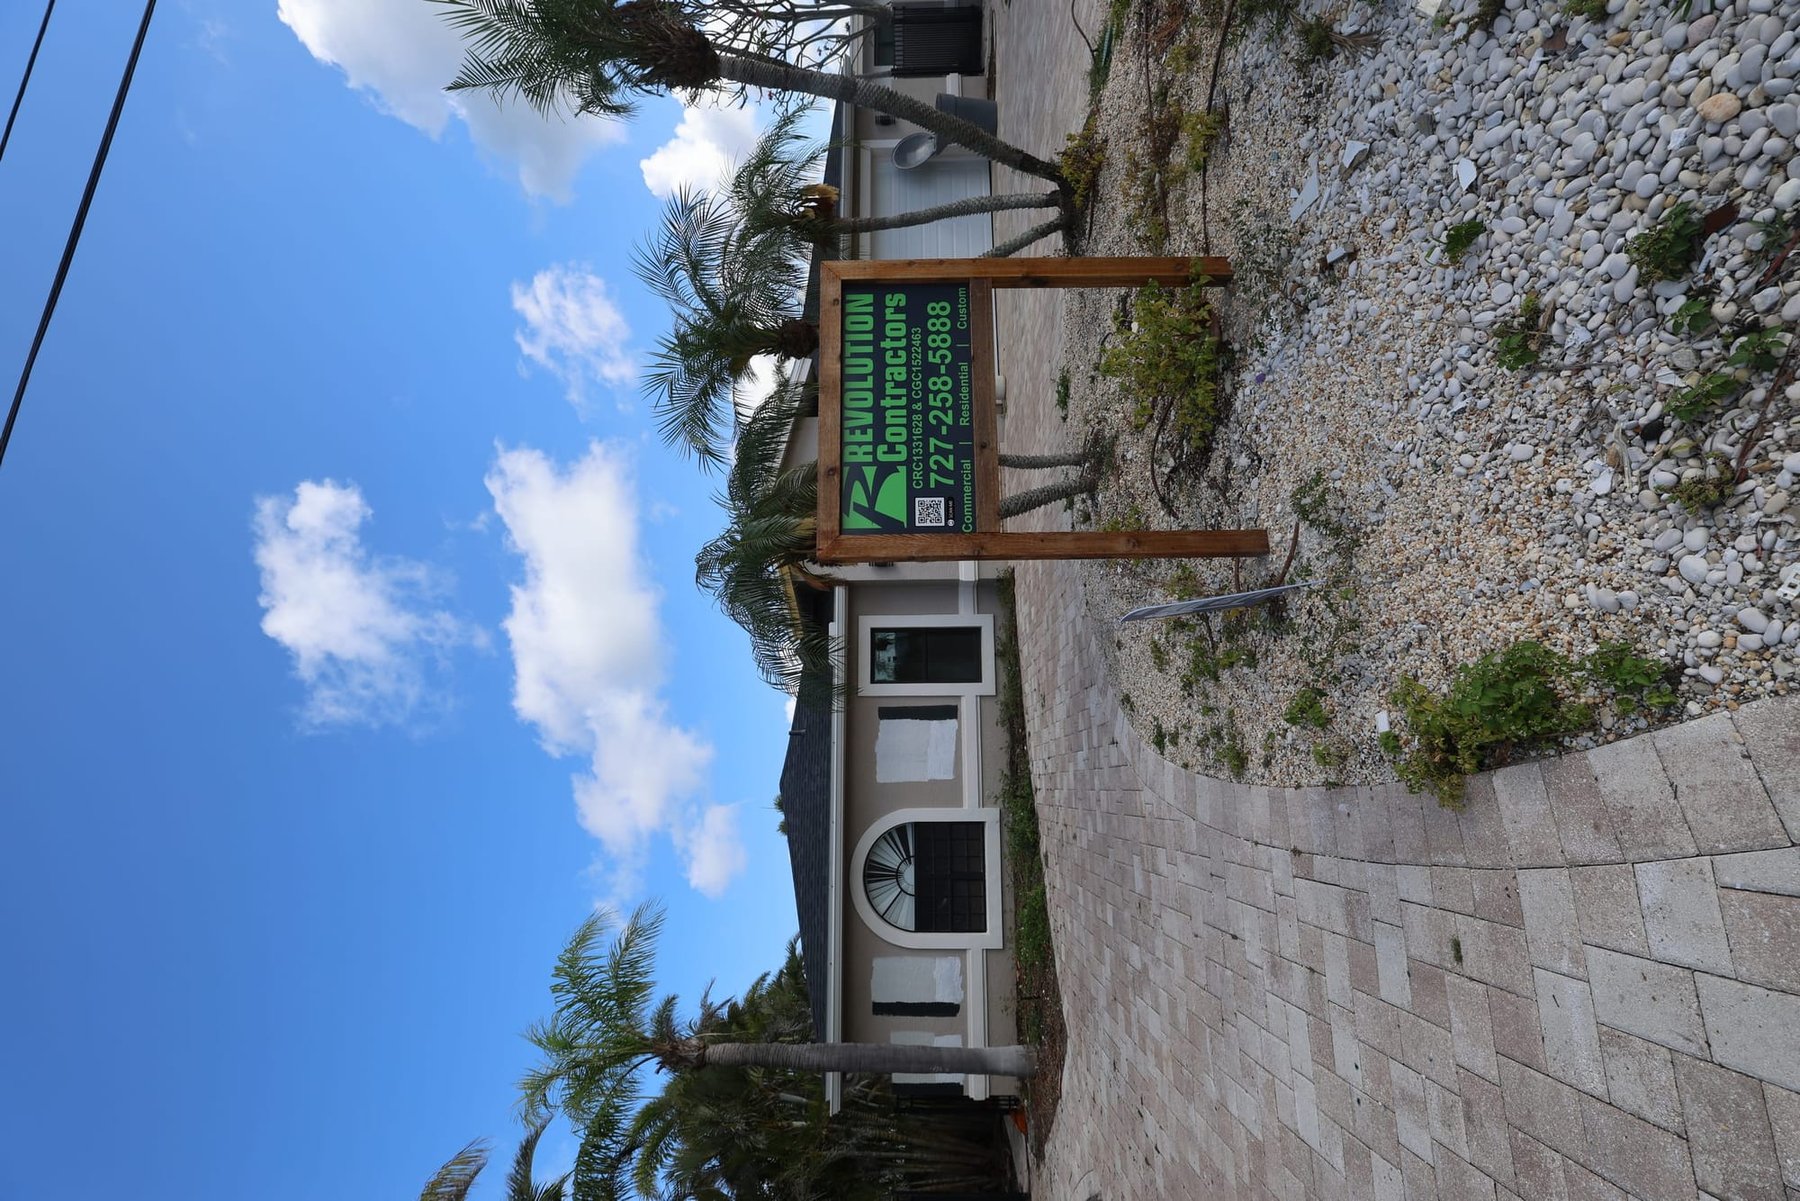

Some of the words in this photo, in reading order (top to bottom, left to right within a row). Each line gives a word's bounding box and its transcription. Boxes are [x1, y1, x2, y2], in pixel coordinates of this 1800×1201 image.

[957, 287, 967, 329] Custom
[843, 293, 874, 463] REVOLUTION
[876, 293, 907, 462] Contractors
[911, 327, 922, 399] CGC1522463
[927, 301, 954, 489] 727-258-5888
[958, 362, 970, 426] Residential
[912, 402, 922, 411] &
[912, 414, 923, 489] CRC1331628
[960, 459, 973, 533] Commercial
